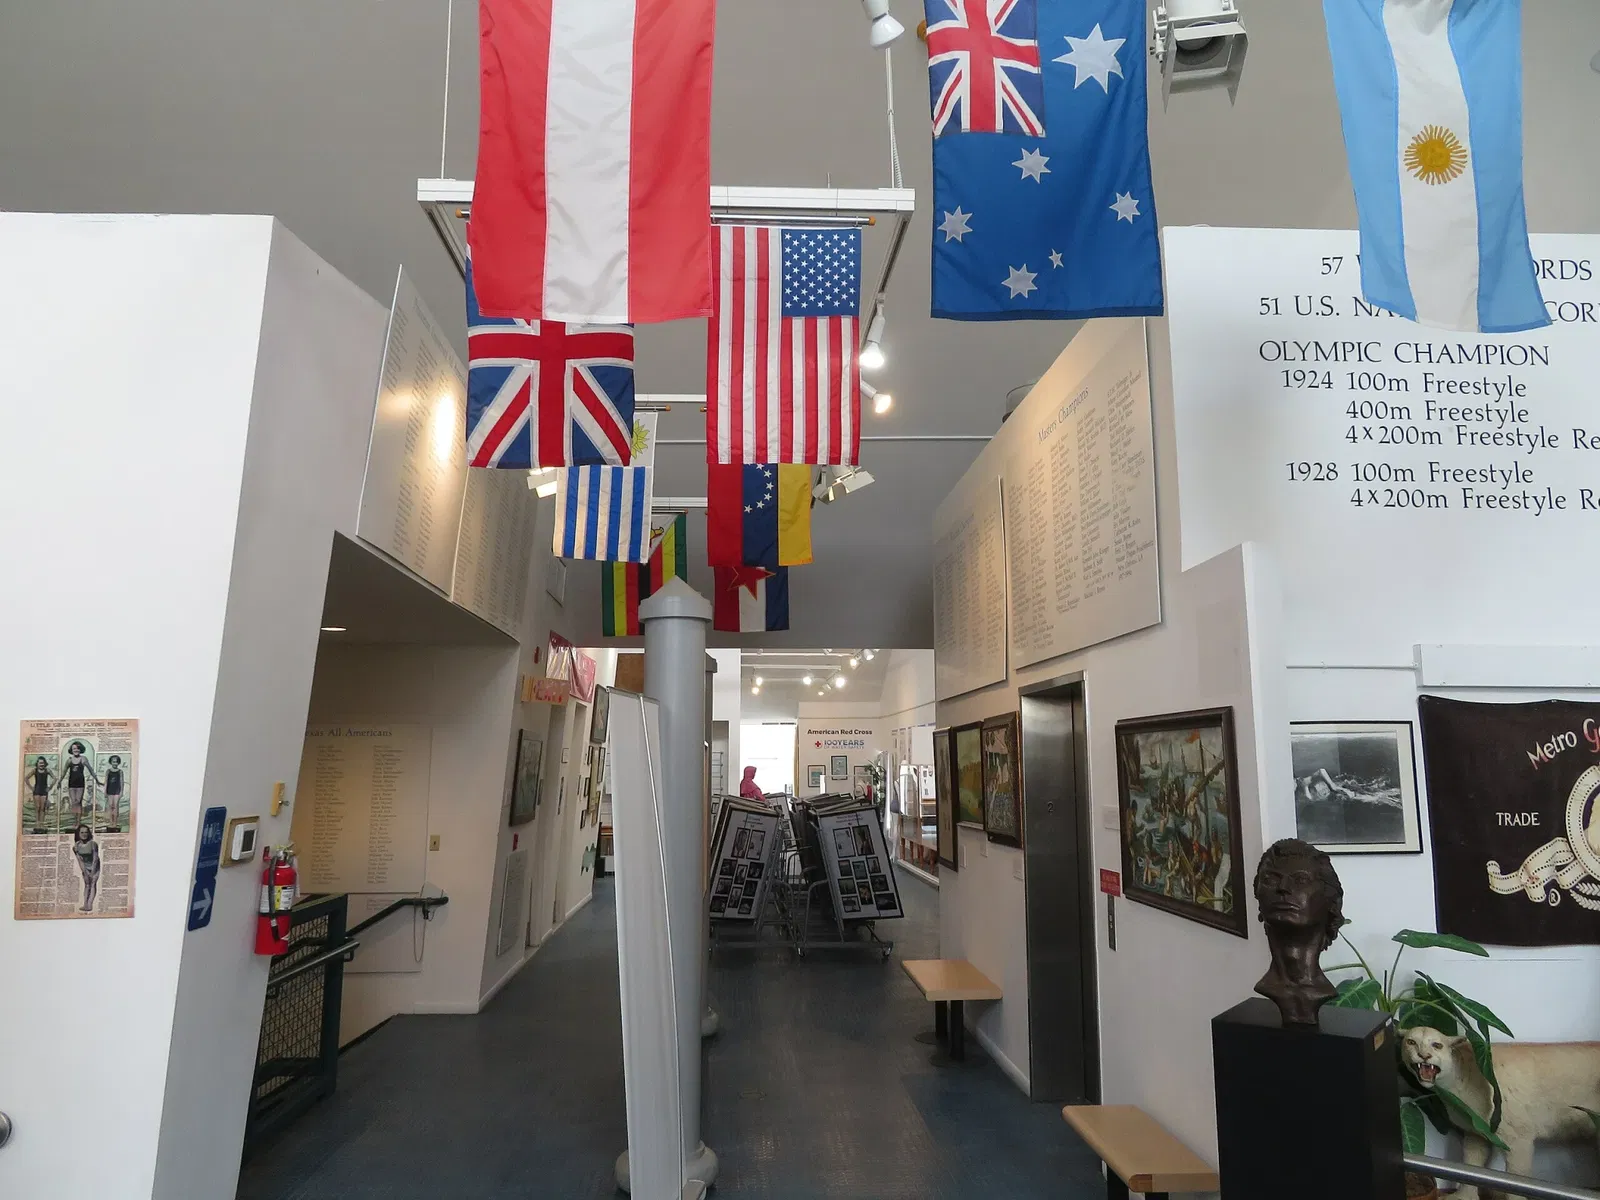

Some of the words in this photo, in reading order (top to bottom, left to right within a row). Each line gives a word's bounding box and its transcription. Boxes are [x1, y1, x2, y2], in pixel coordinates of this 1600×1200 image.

[1321, 256, 1344, 276] 57
[1259, 297, 1283, 316] 51
[1295, 295, 1340, 317] U.S.
[1543, 300, 1600, 324] COR
[1259, 340, 1382, 364] OLYMPIC
[1394, 342, 1549, 367] CHAMPION
[1281, 369, 1334, 390] 1924
[1347, 372, 1410, 392] 100m
[1423, 372, 1527, 402] Freestyle
[1346, 400, 1412, 420] 400m
[1425, 400, 1529, 430] Freestyle
[1456, 424, 1559, 455] Freestyle
[1286, 461, 1339, 481] 1928
[1351, 462, 1416, 482] 100m
[1428, 461, 1534, 490] Freestyle
[1462, 486, 1567, 517] Freestyle
[327, 728, 342, 737] All
[345, 728, 393, 737] Americans
[1525, 730, 1578, 771] Metro
[1047, 801, 1054, 813] 2
[1496, 812, 1541, 827] TRADE
